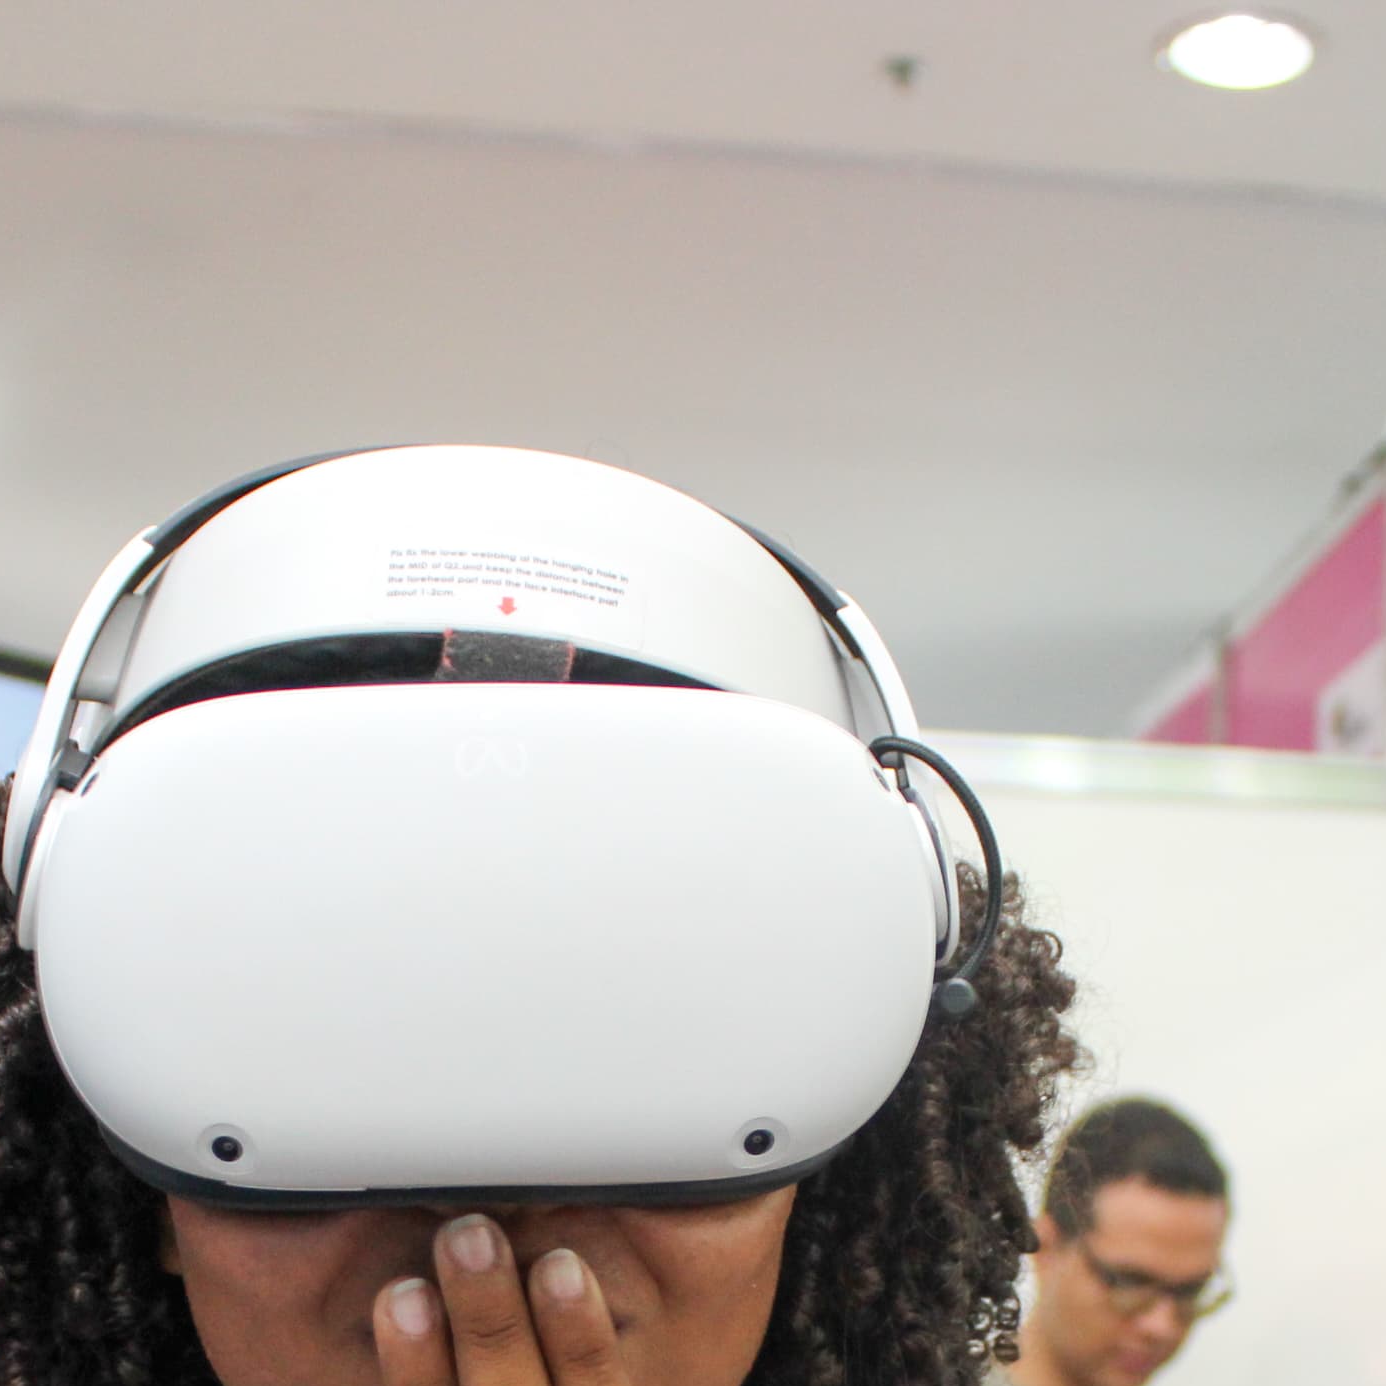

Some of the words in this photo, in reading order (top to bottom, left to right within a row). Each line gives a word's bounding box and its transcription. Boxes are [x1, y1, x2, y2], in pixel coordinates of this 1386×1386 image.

[439, 549, 468, 557] lower
[471, 551, 517, 562] webbing
[533, 556, 549, 565] the
[552, 560, 593, 576] hanging
[596, 568, 617, 580] hole
[389, 562, 405, 570] the
[408, 562, 428, 570] MID
[485, 564, 512, 574] keep
[515, 567, 531, 576] the
[535, 570, 578, 584] distance
[581, 578, 625, 596] between
[481, 578, 502, 586] and
[505, 580, 521, 588] the
[386, 588, 417, 598] about
